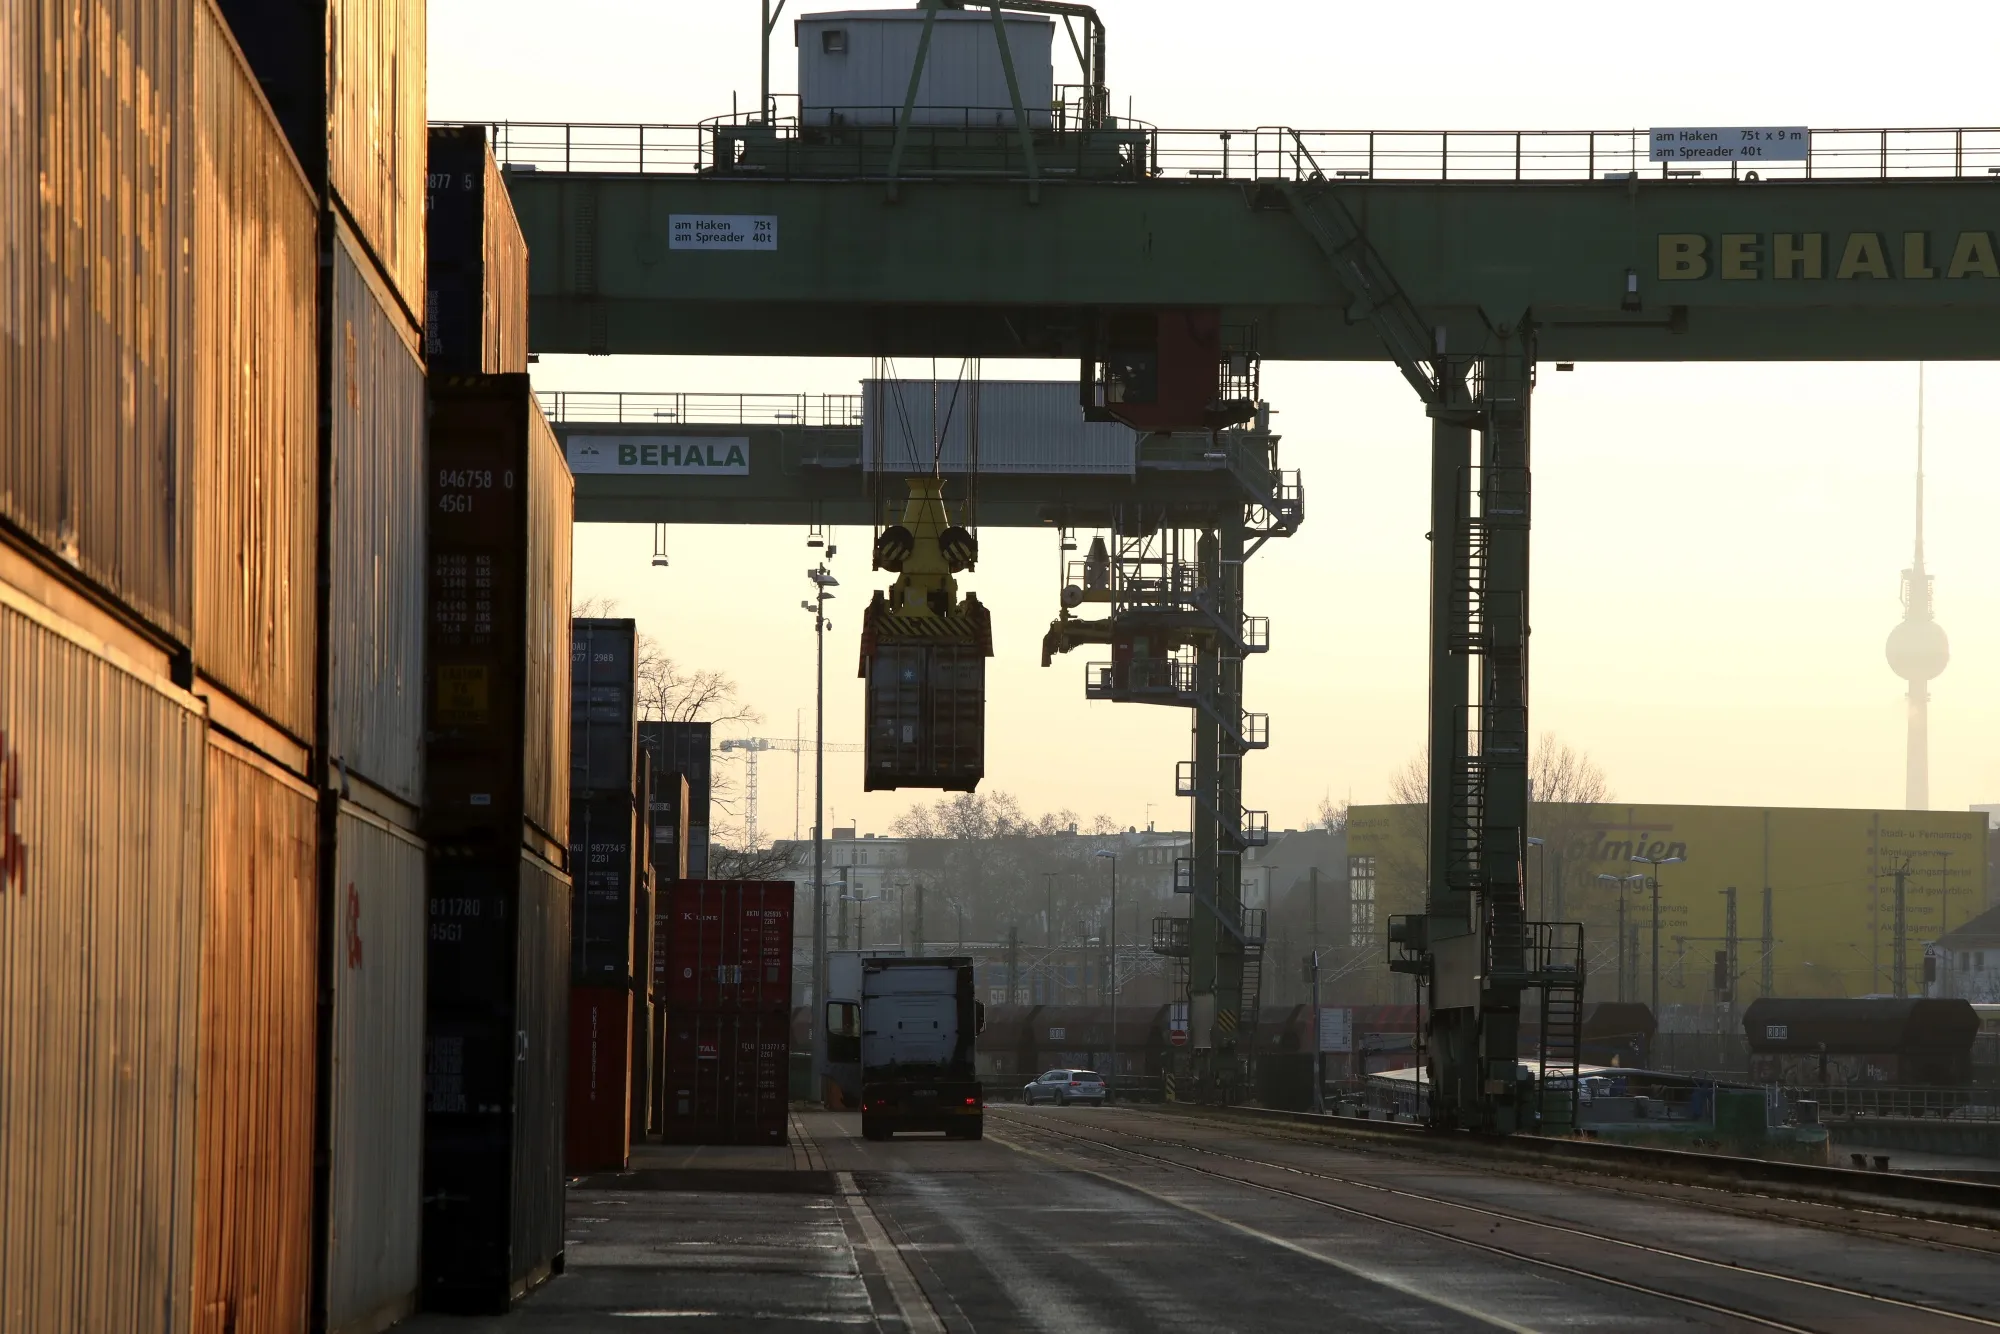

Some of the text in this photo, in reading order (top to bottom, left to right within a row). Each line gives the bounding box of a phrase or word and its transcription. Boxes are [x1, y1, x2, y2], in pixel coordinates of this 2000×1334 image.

[1656, 130, 1802, 141] am Haken 75t x 9 m
[1656, 146, 1762, 158] am Spreader 40t
[464, 174, 472, 189] 5
[674, 220, 772, 230] am Haken 75t
[674, 232, 772, 244] am Spreader 40t
[1657, 231, 2000, 280] BEHALA
[618, 444, 746, 467] BEHALA
[439, 469, 514, 489] 846758 0
[438, 494, 472, 512] 45G1
[1768, 1027, 1786, 1037] RBH
